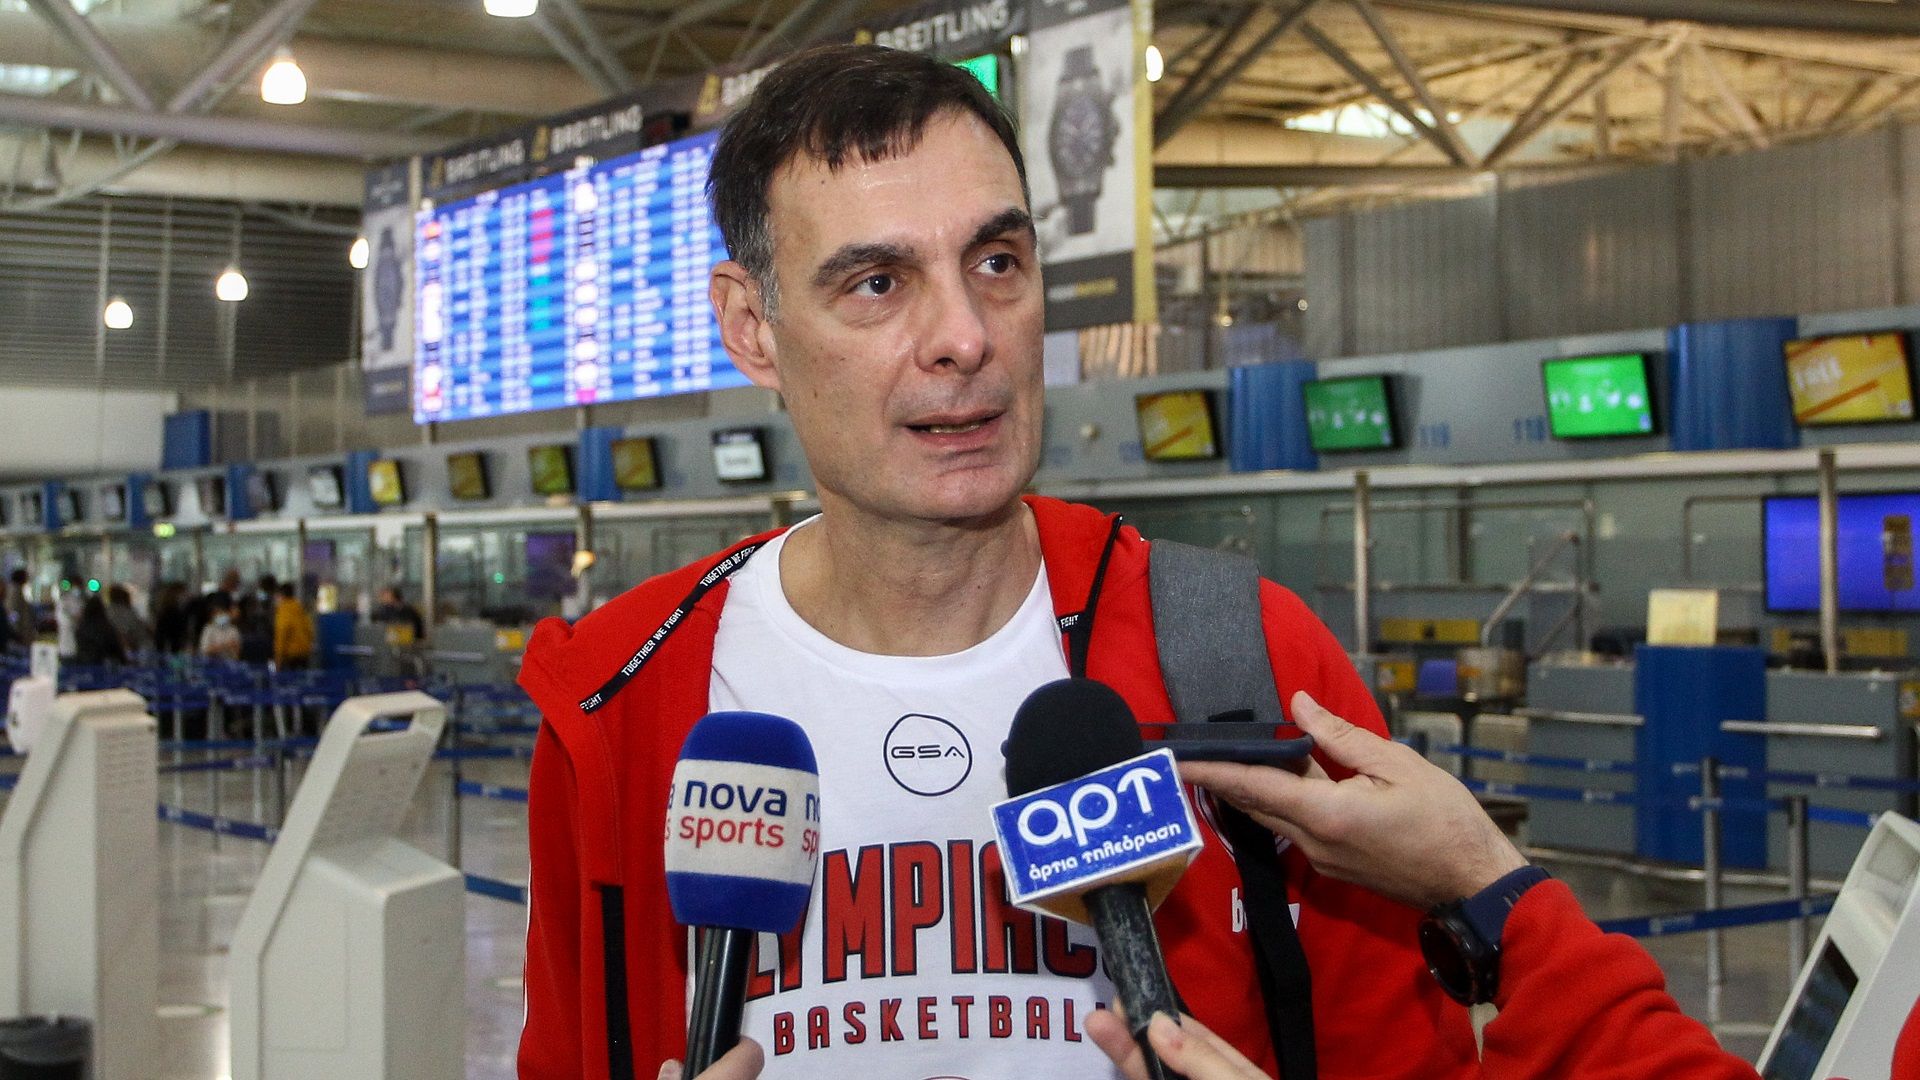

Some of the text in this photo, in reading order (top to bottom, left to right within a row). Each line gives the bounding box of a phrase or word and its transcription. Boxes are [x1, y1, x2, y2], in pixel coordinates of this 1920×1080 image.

[700, 558, 734, 587] TOGETHER
[621, 607, 684, 677] TOGETHER WE FIGHT
[891, 744, 966, 759] GSA
[683, 780, 788, 818] nova
[679, 815, 785, 849] sports
[773, 994, 1106, 1057] BASKETBAL
